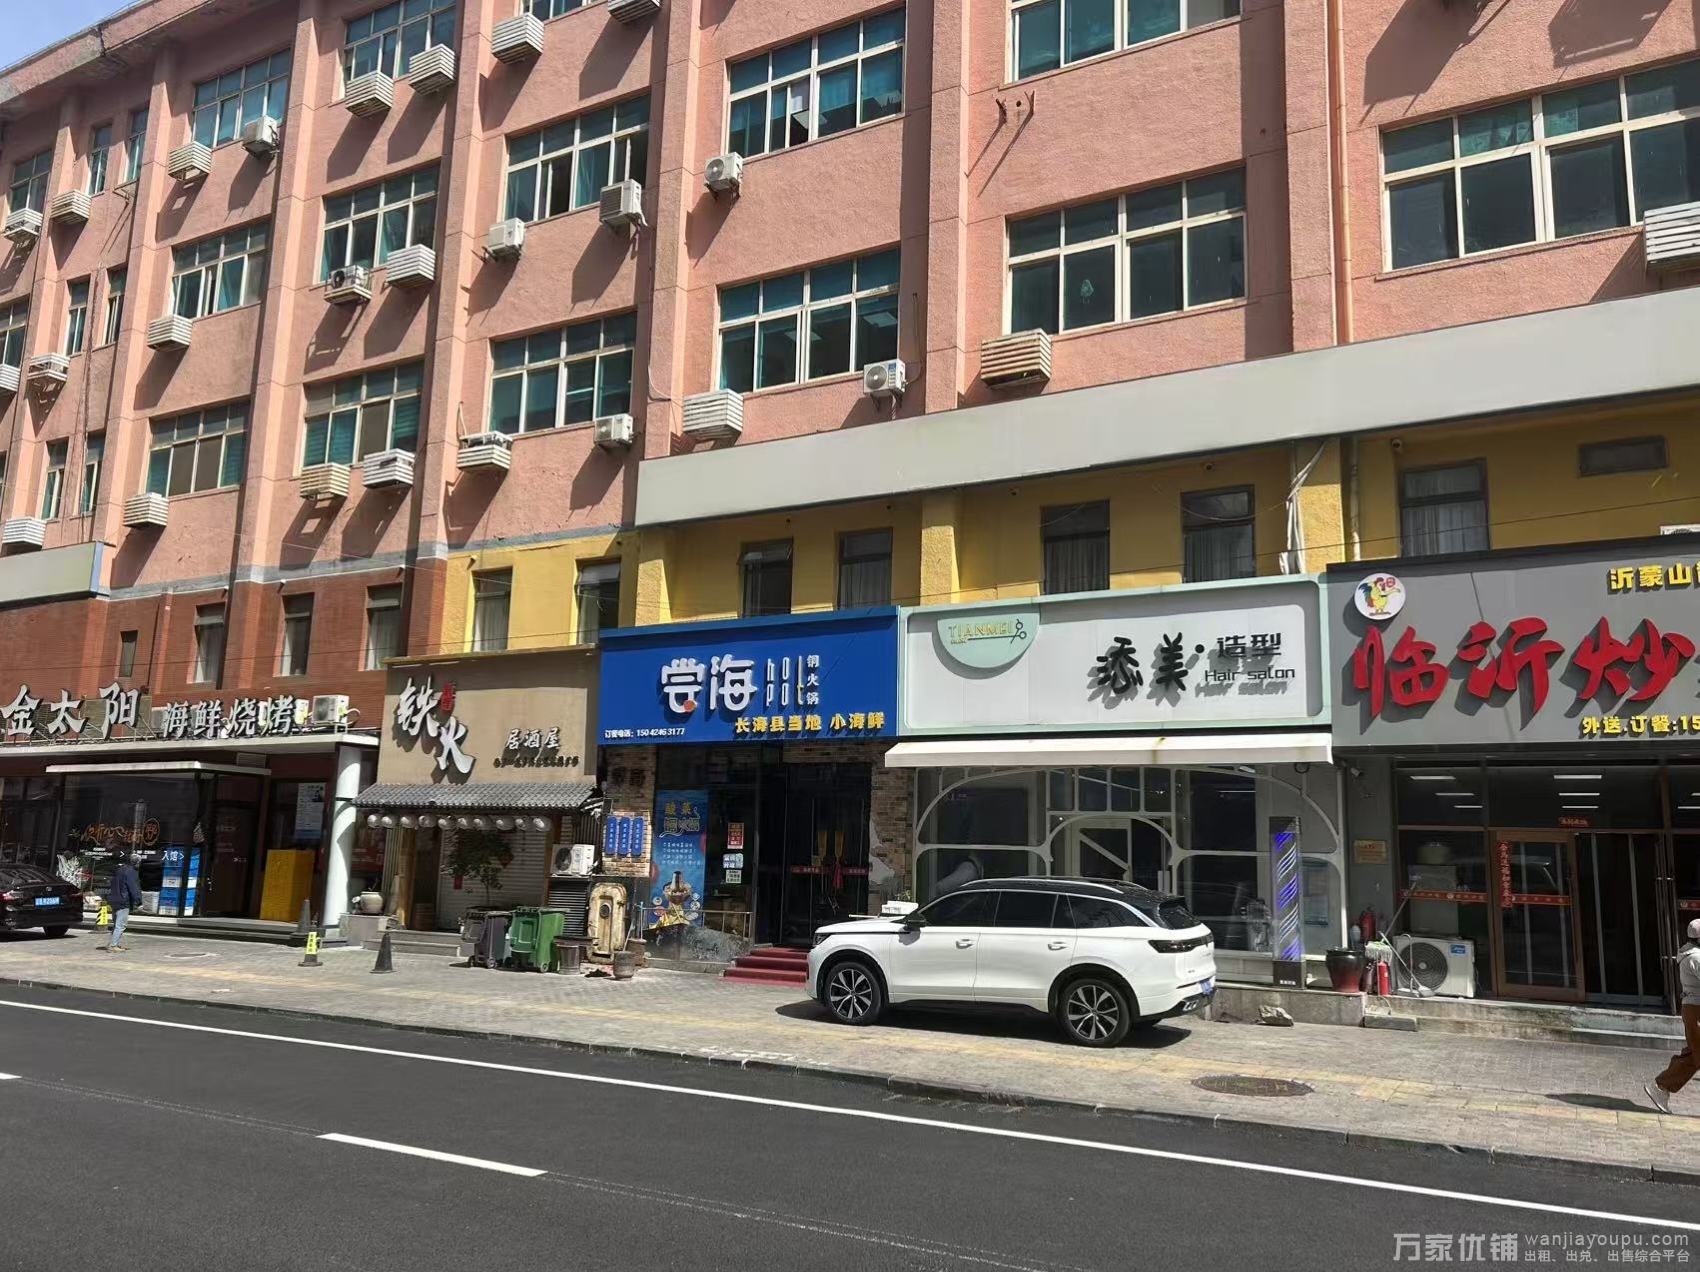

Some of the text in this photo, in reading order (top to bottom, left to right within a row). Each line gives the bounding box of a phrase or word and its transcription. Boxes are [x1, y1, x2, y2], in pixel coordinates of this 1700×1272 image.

[948, 620, 1012, 638] TIANMEI
[1216, 633, 1281, 658] 造型
[1204, 667, 1295, 682] Hair salon
[1354, 616, 1696, 719] 临沂炒
[0, 682, 142, 740] 金太阳
[163, 694, 294, 738] 海鲜烧烤
[735, 711, 885, 733] 长海县当地 小海鲜
[506, 727, 559, 750] 居酒屋
